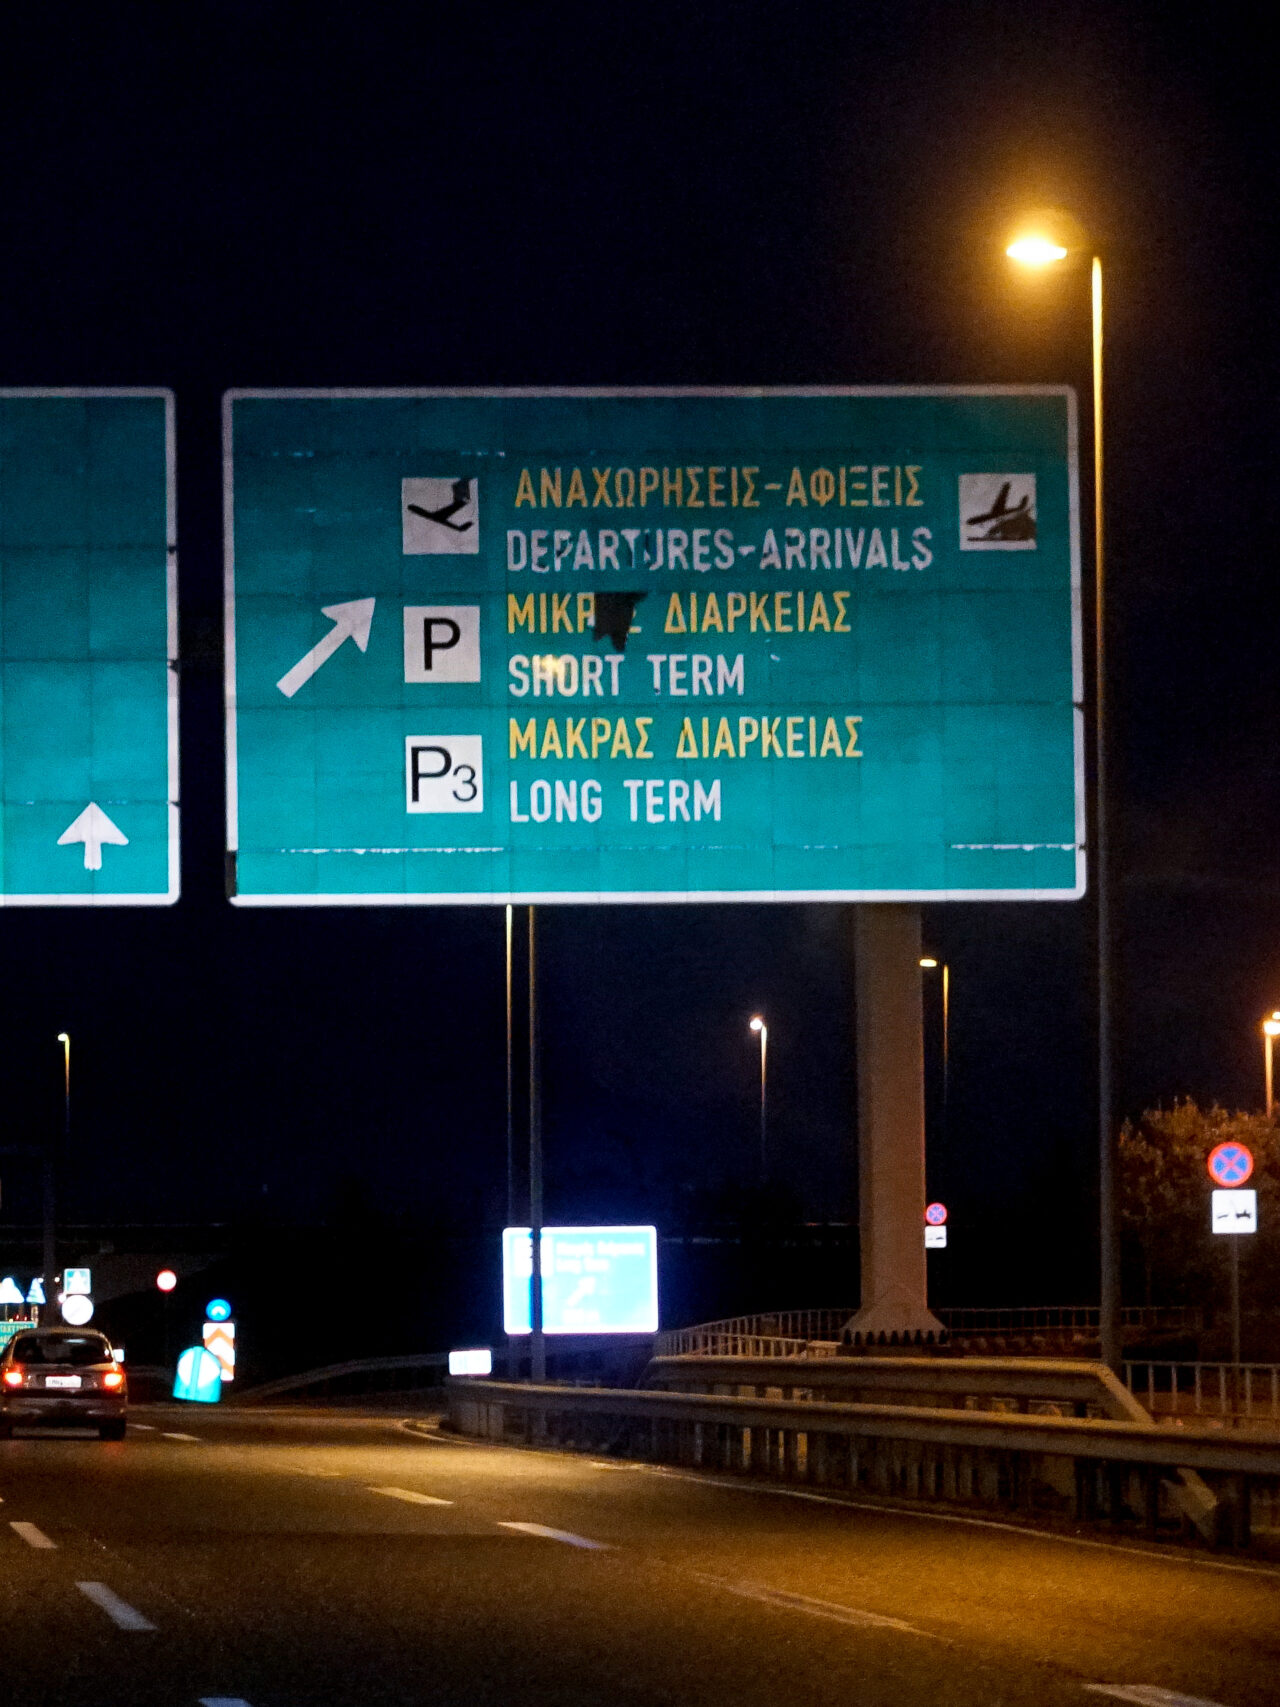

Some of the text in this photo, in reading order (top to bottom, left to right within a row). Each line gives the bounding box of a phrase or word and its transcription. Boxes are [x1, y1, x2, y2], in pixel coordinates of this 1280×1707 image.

[507, 527, 932, 572] DEPARTURES-ARRIVALS
[508, 592, 850, 633] ΜΙΚΡ ΔΙΑΡΚΕΙΑΣ
[424, 617, 461, 671] P
[509, 654, 744, 696] SHORT TERM
[510, 717, 862, 758] ΜΑΚΡΑΣ ΔΙΑΡΚΕΙΑΣ
[510, 780, 721, 823] LONG TERM
